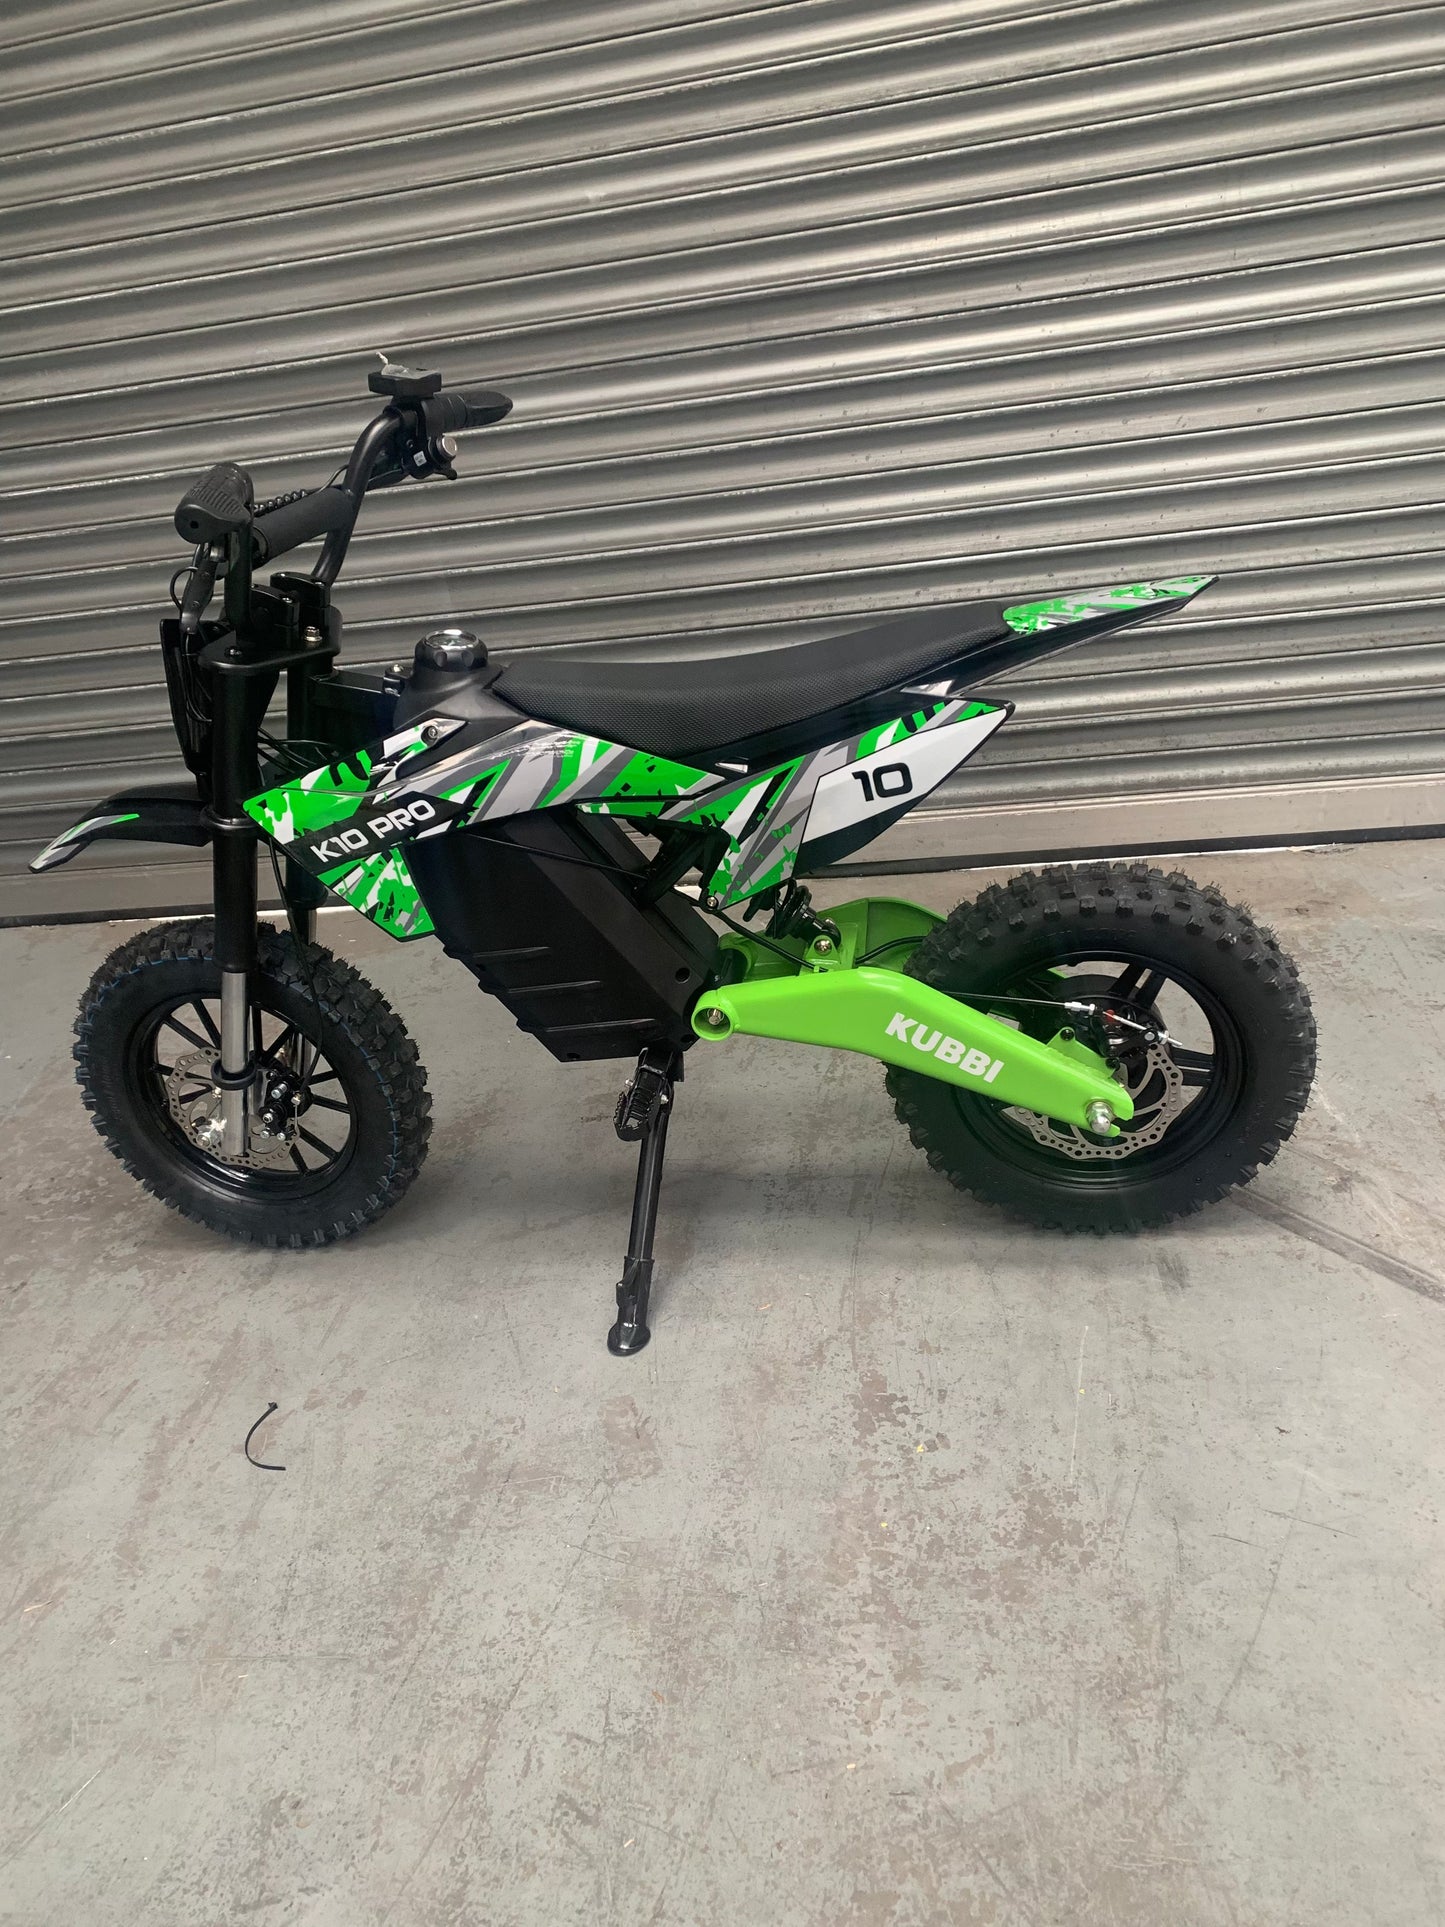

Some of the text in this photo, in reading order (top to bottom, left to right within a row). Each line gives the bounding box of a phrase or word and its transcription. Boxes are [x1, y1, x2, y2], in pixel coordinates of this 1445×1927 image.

[851, 762, 913, 802] 10
[310, 799, 436, 863] K10 PRO
[884, 1011, 1005, 1084] KUBBI
